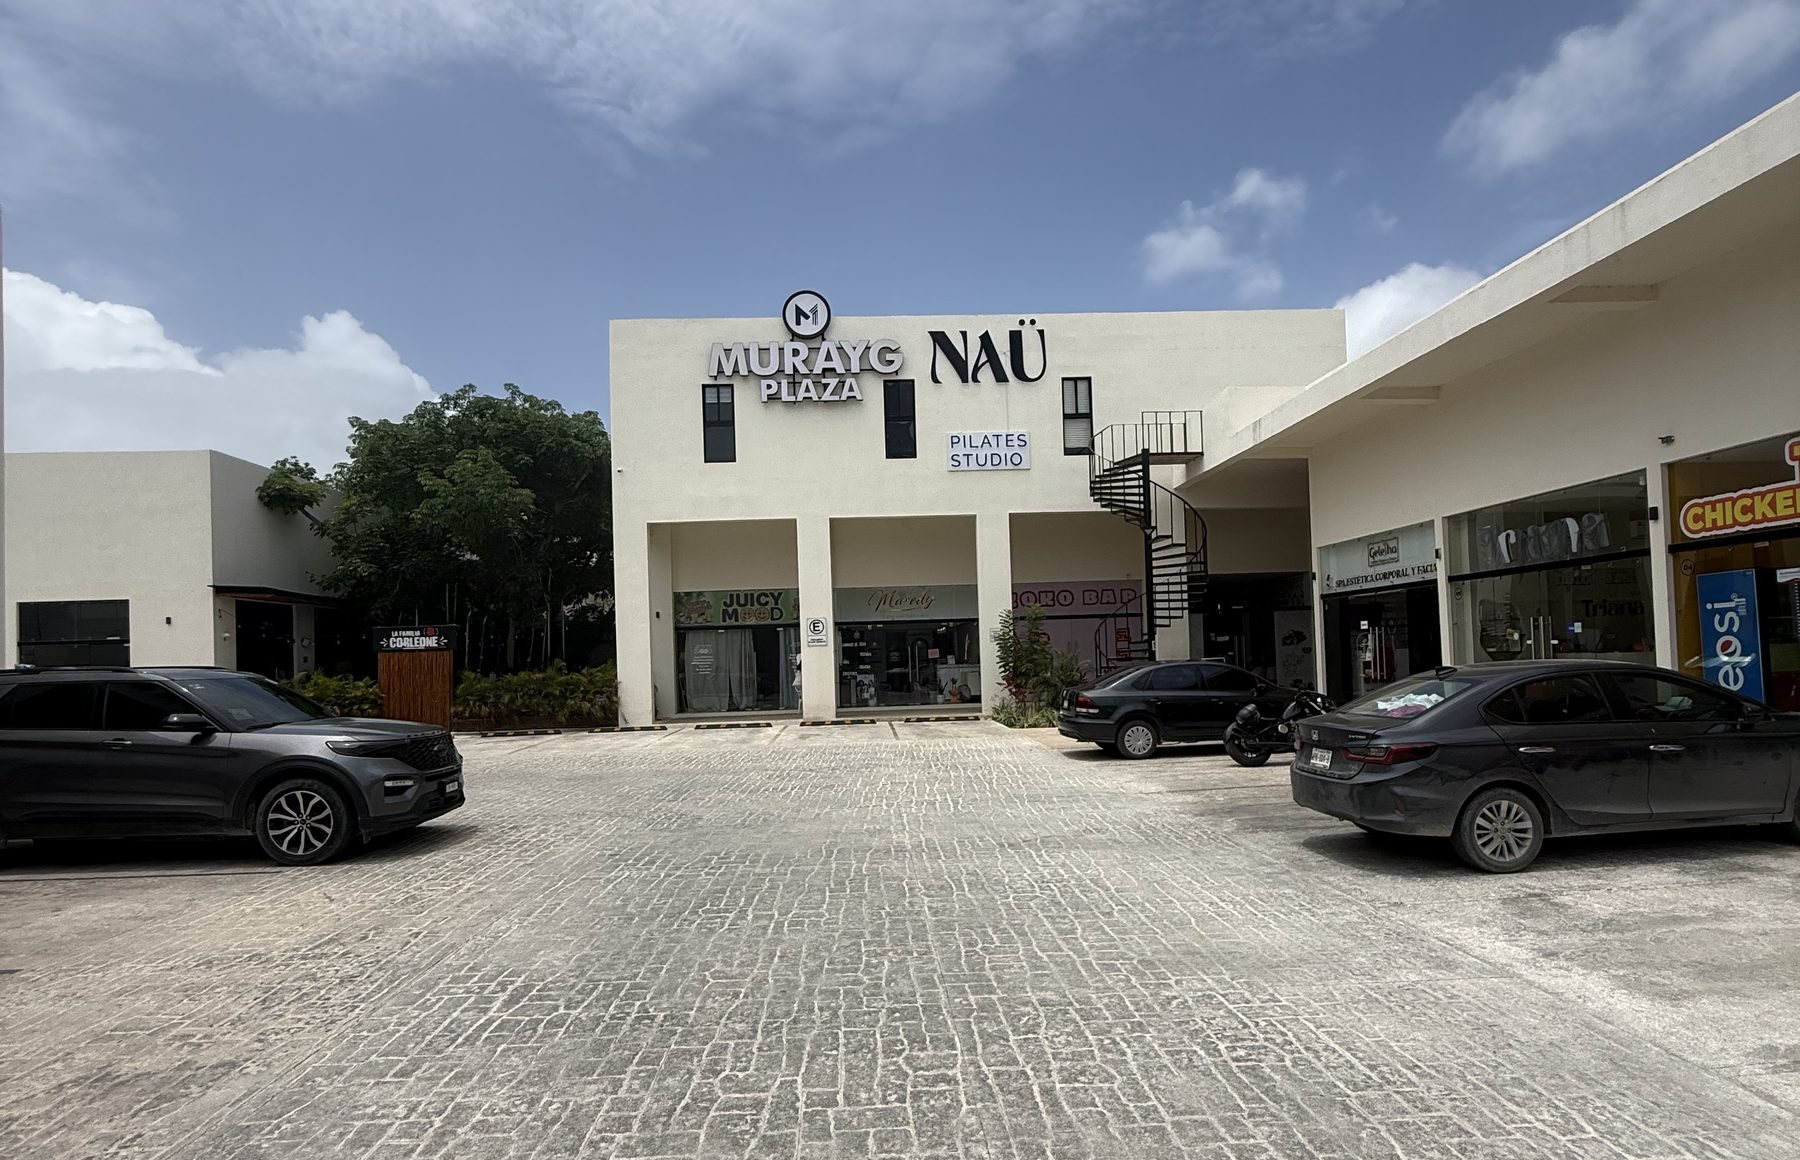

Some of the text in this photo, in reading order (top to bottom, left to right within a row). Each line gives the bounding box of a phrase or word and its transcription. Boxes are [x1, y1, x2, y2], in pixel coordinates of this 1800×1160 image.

[708, 339, 904, 377] MURAYG
[928, 318, 1046, 384] NAÜ
[760, 377, 863, 403] PLAZA
[950, 433, 1028, 449] PILATES
[950, 452, 1023, 467] STUDIO
[1686, 487, 1800, 531] CHICKE
[1375, 568, 1409, 581] CORPORAL
[1411, 567, 1417, 576] Y
[722, 592, 784, 608] JUICY
[1082, 588, 1137, 605] BAP
[721, 607, 784, 623] MOOD
[1581, 598, 1645, 617] Triana
[812, 621, 821, 632] E
[389, 636, 439, 648] CORLEONE
